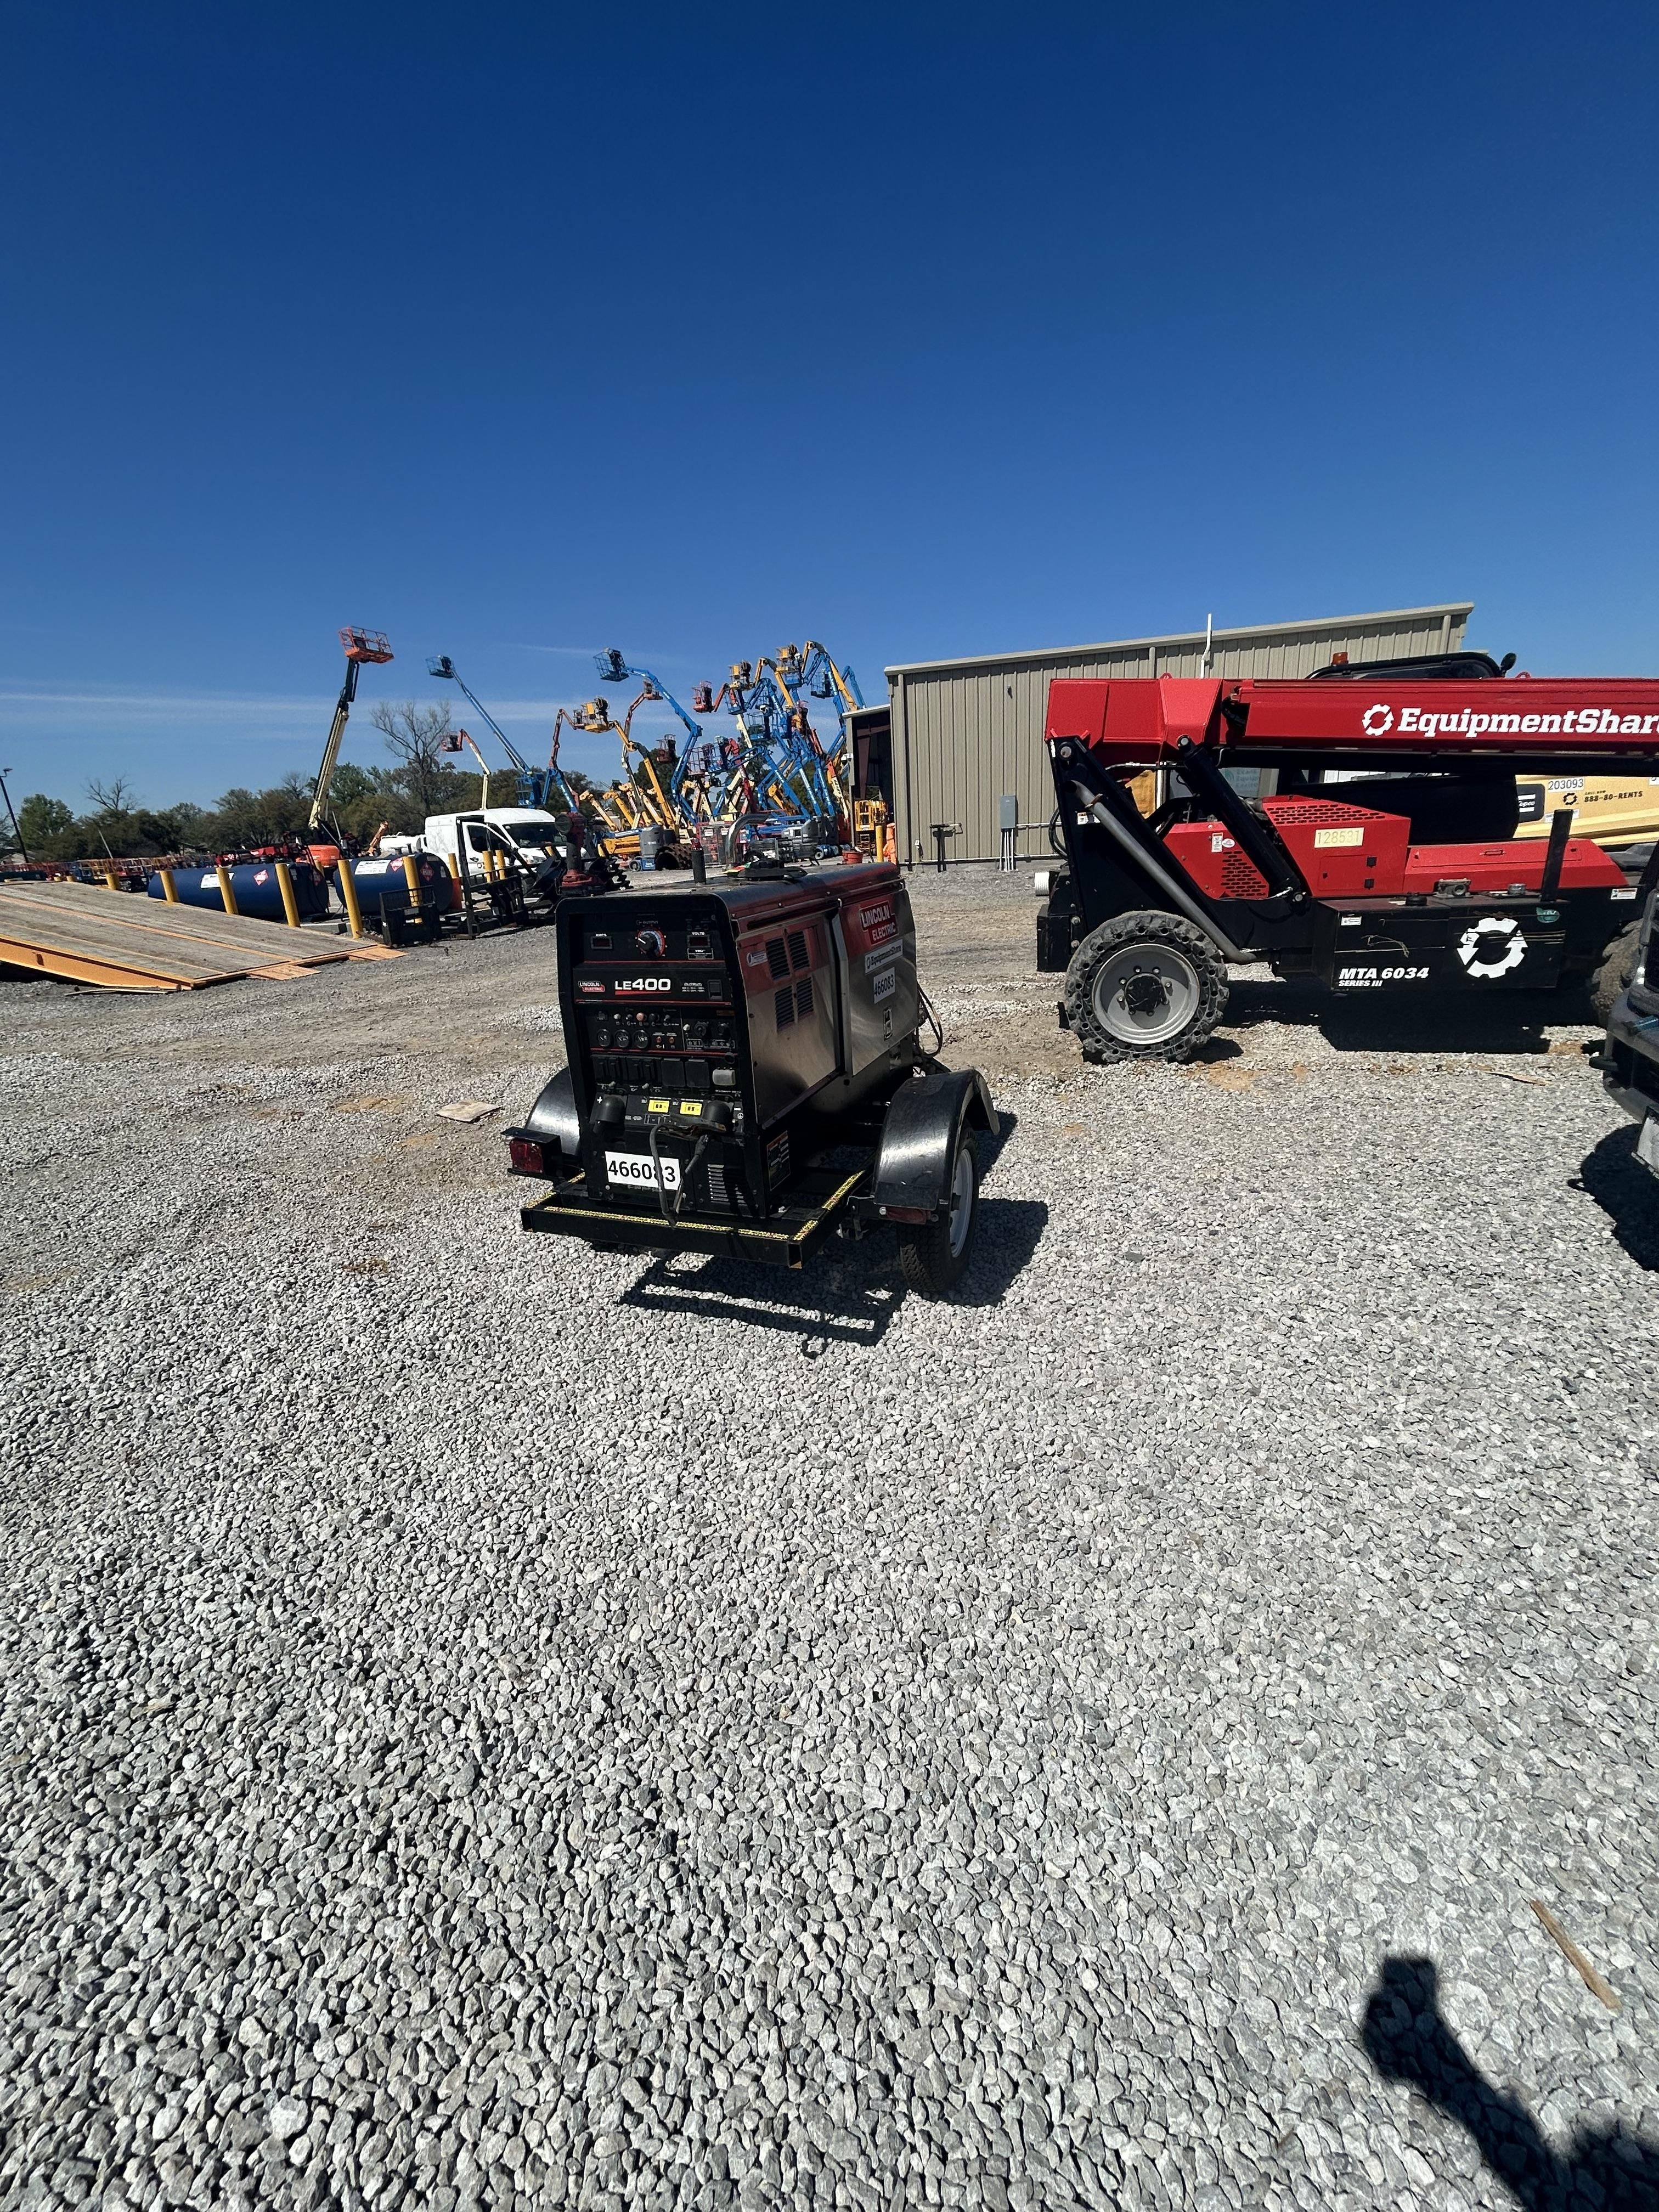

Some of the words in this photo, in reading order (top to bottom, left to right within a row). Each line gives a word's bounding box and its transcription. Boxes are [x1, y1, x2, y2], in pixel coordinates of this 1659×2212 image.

[1397, 708, 1659, 737] EquipmentShar
[1548, 778, 1584, 791] 203093
[1584, 791, 1643, 803] 888-80-RENTS
[1317, 830, 1359, 844] 128531
[861, 906, 890, 927] LINCOLN
[872, 922, 896, 941] ELECTRIC
[871, 945, 901, 966] EquipmentShare
[1339, 968, 1378, 979] MTA
[1381, 967, 1430, 979] 6034
[614, 978, 671, 991] LE400
[874, 974, 894, 996] 466083
